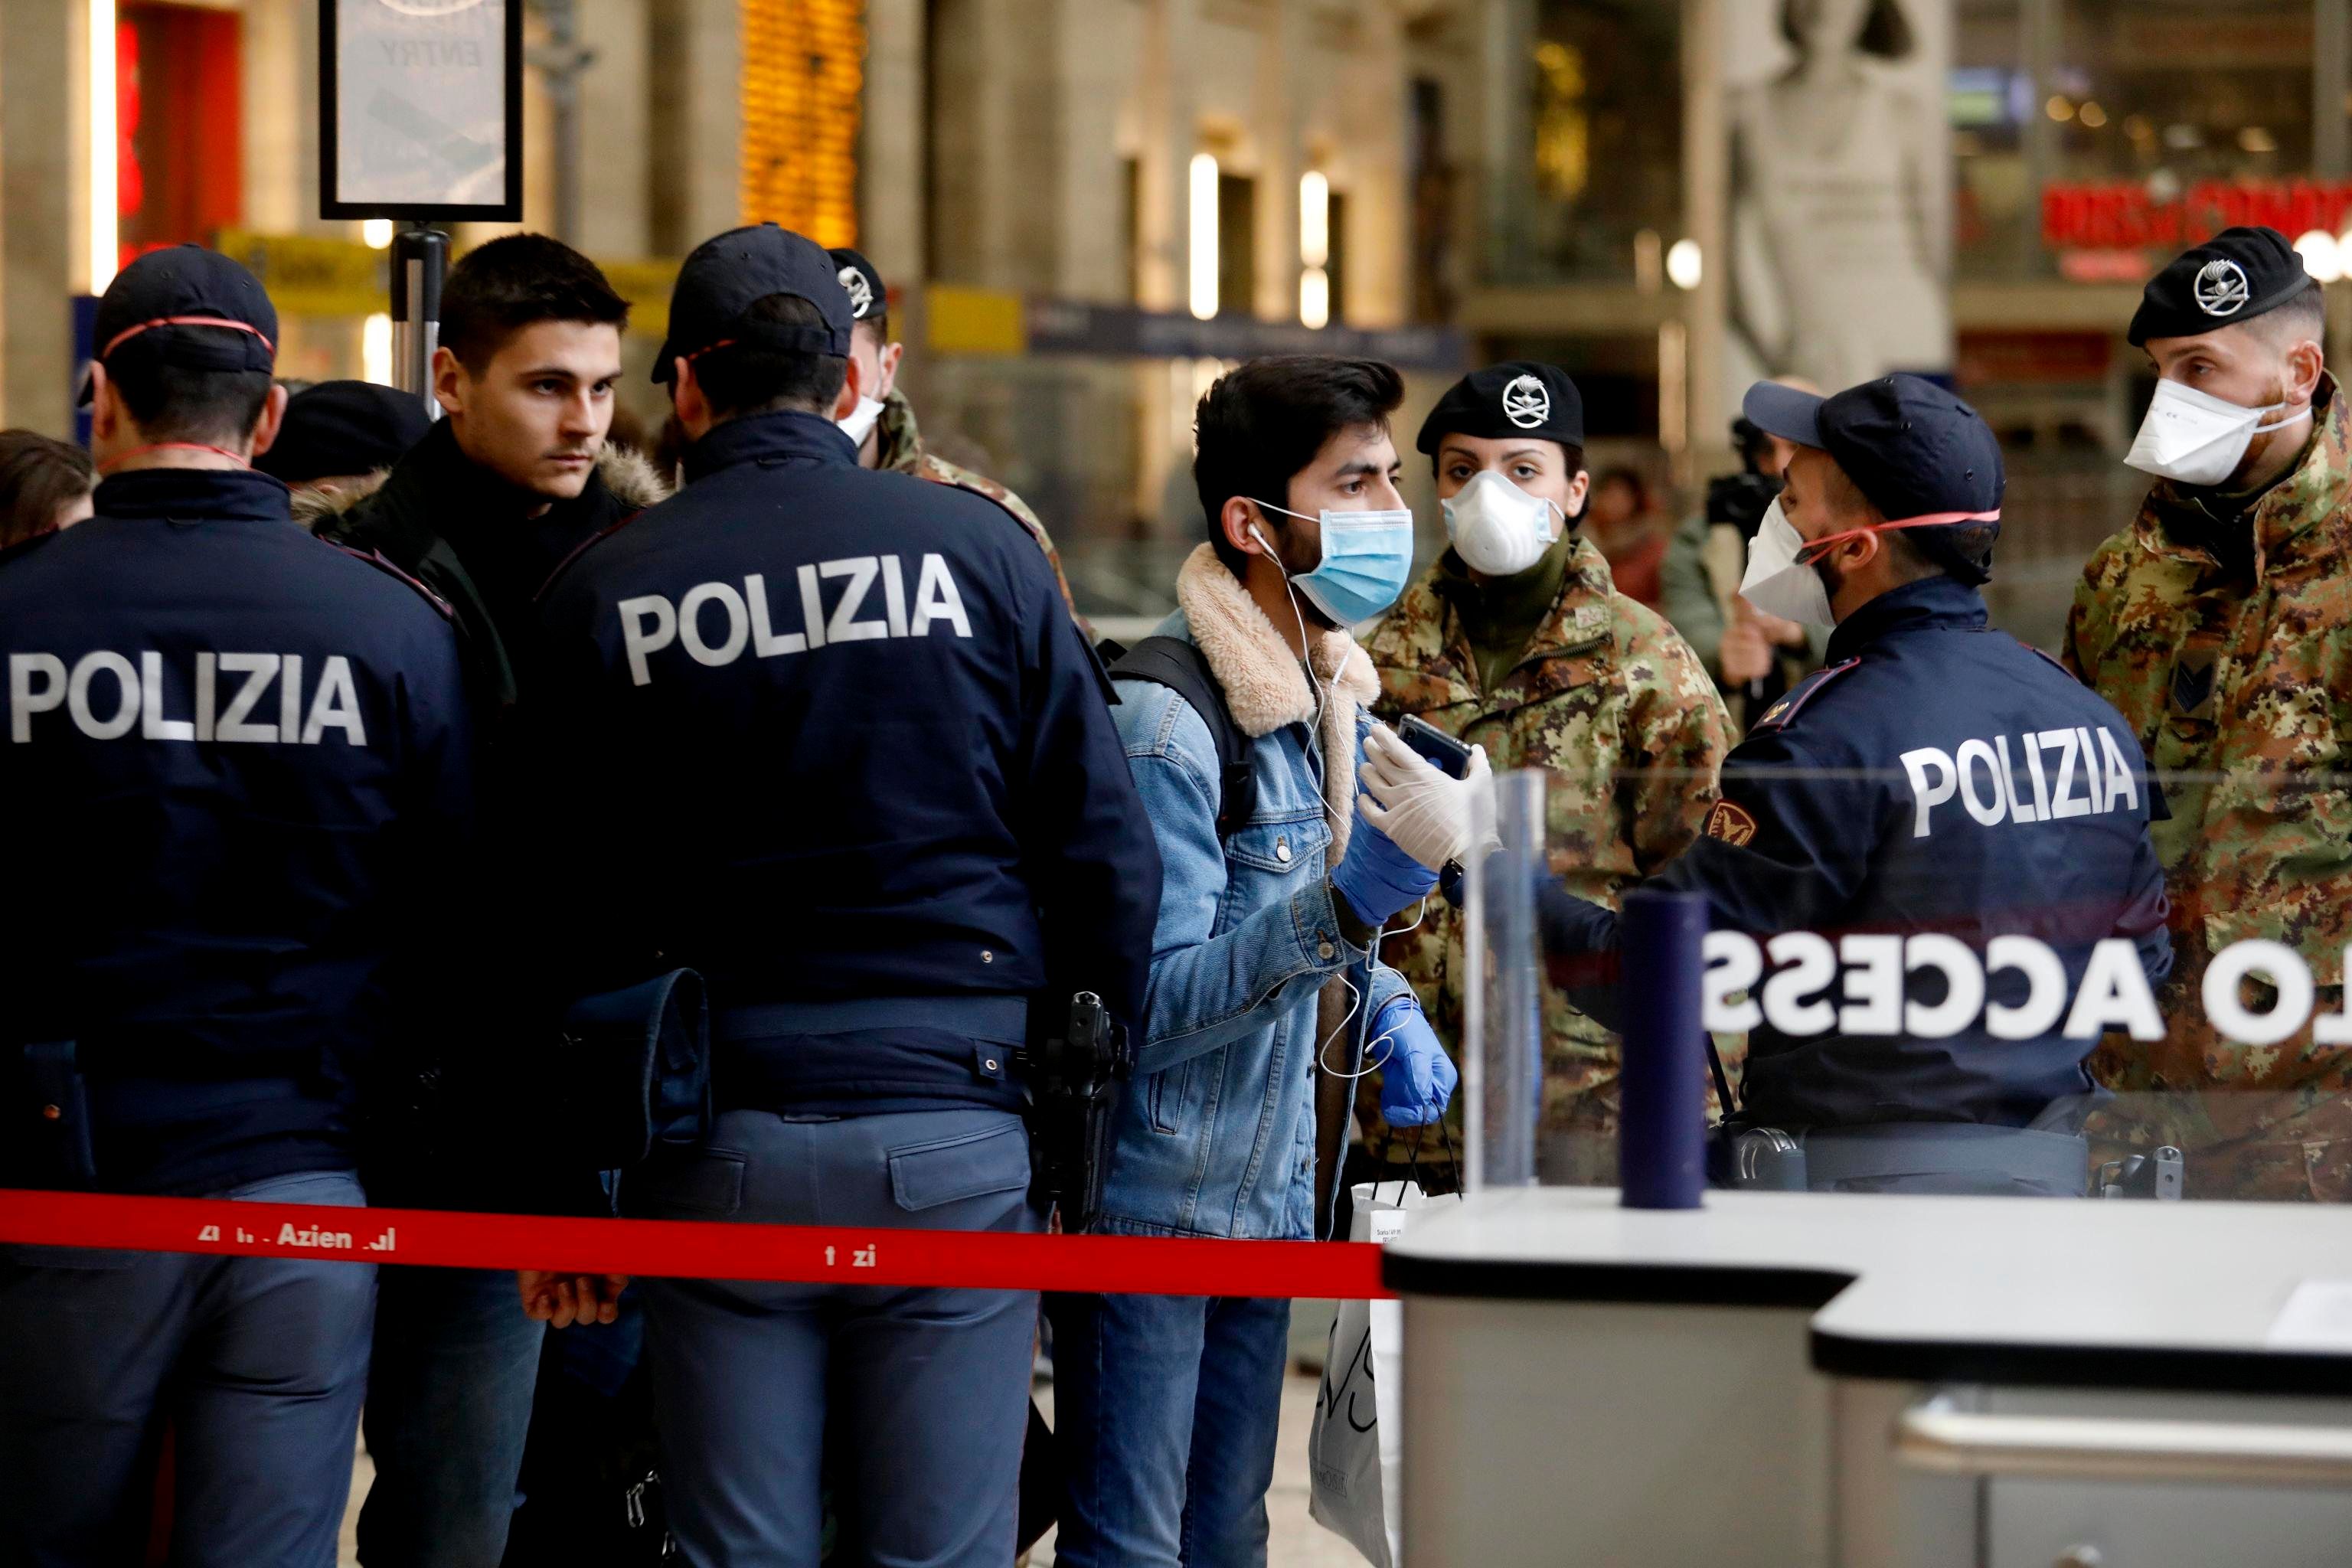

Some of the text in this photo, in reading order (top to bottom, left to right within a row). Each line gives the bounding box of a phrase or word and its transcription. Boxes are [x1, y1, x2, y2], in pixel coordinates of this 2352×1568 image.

[617, 552, 974, 688] POLIZIA
[8, 649, 368, 747] POLIZIA
[1899, 726, 2139, 839] POLIZIA
